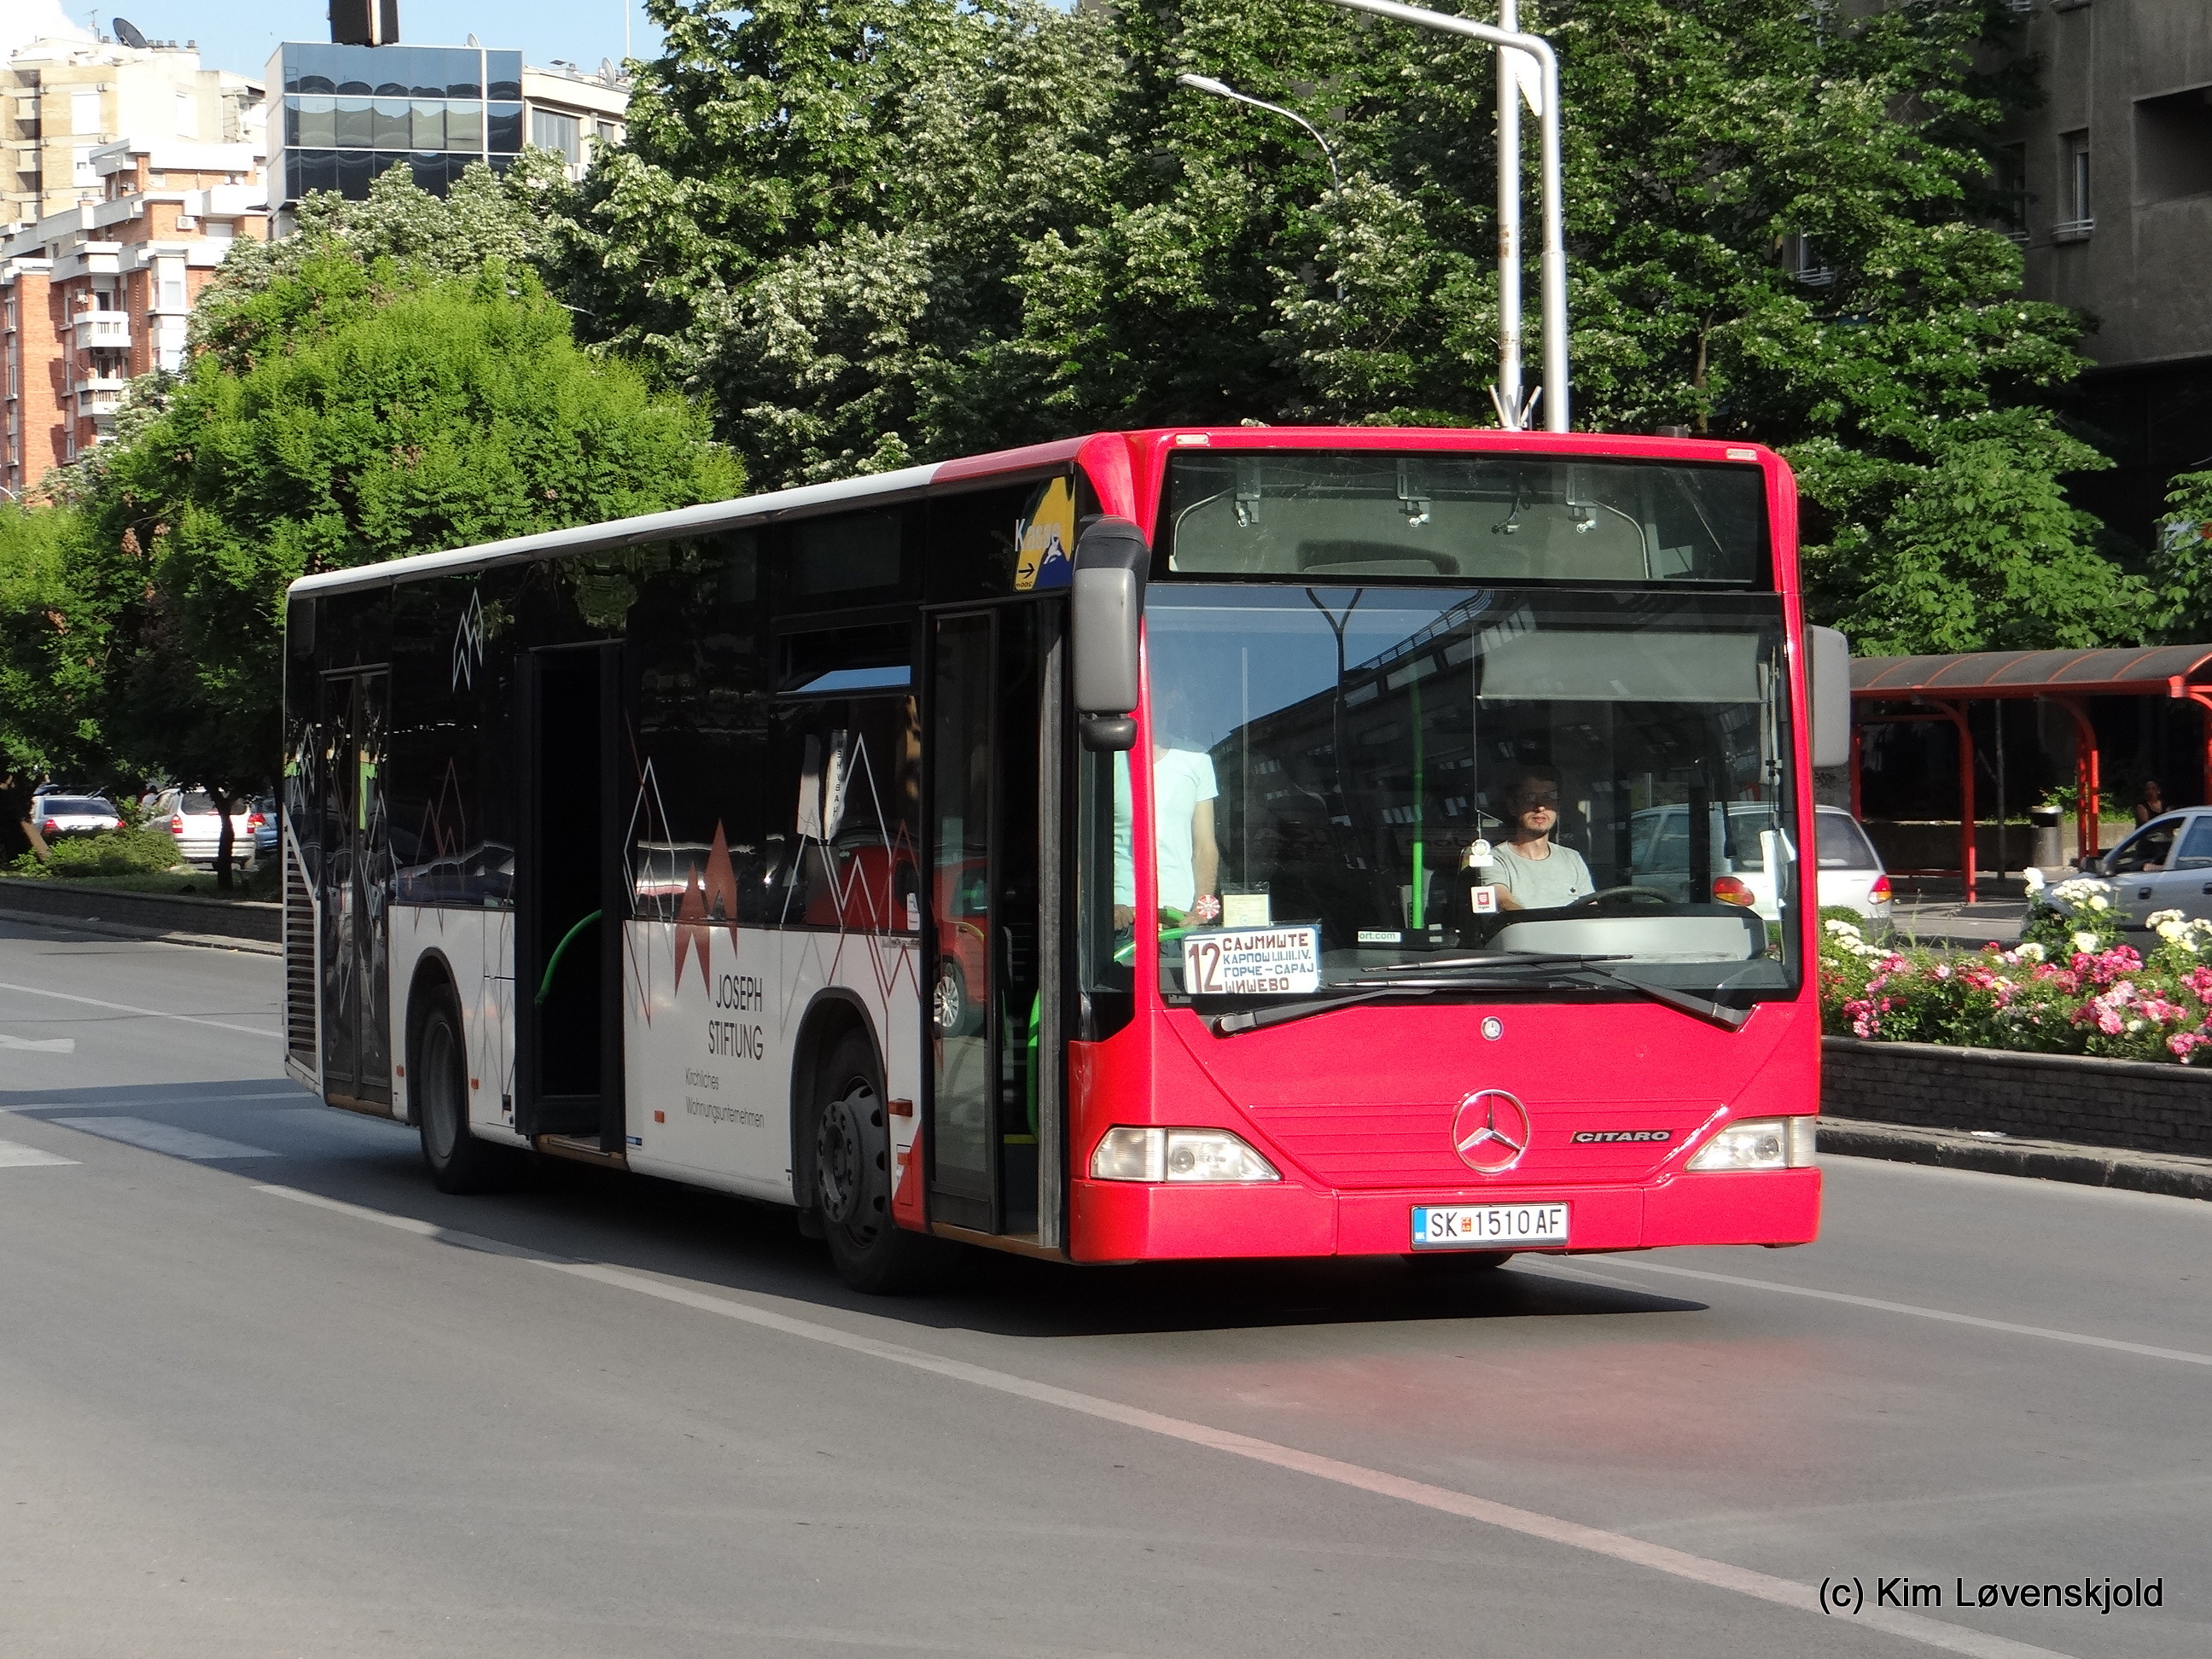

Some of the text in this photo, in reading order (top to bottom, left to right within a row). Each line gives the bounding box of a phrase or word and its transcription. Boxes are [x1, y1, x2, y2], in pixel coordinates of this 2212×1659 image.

[1222, 933, 1309, 952] САЈМИШТЕ
[1188, 942, 1223, 993] 12
[1223, 952, 1271, 965] КАРПОШ
[1224, 965, 1263, 978] ГОРЧЕ
[1274, 963, 1314, 975] САРАЈ
[715, 974, 763, 1013] JOSEPH
[1225, 976, 1289, 993] ШИШЕВО
[707, 1020, 764, 1061] STIFTUNG
[684, 1068, 719, 1091] Kirchliches
[685, 1096, 765, 1129] Wohnungsunternehmen
[1575, 1131, 1671, 1143] CITARO
[1430, 1211, 1458, 1238] SK
